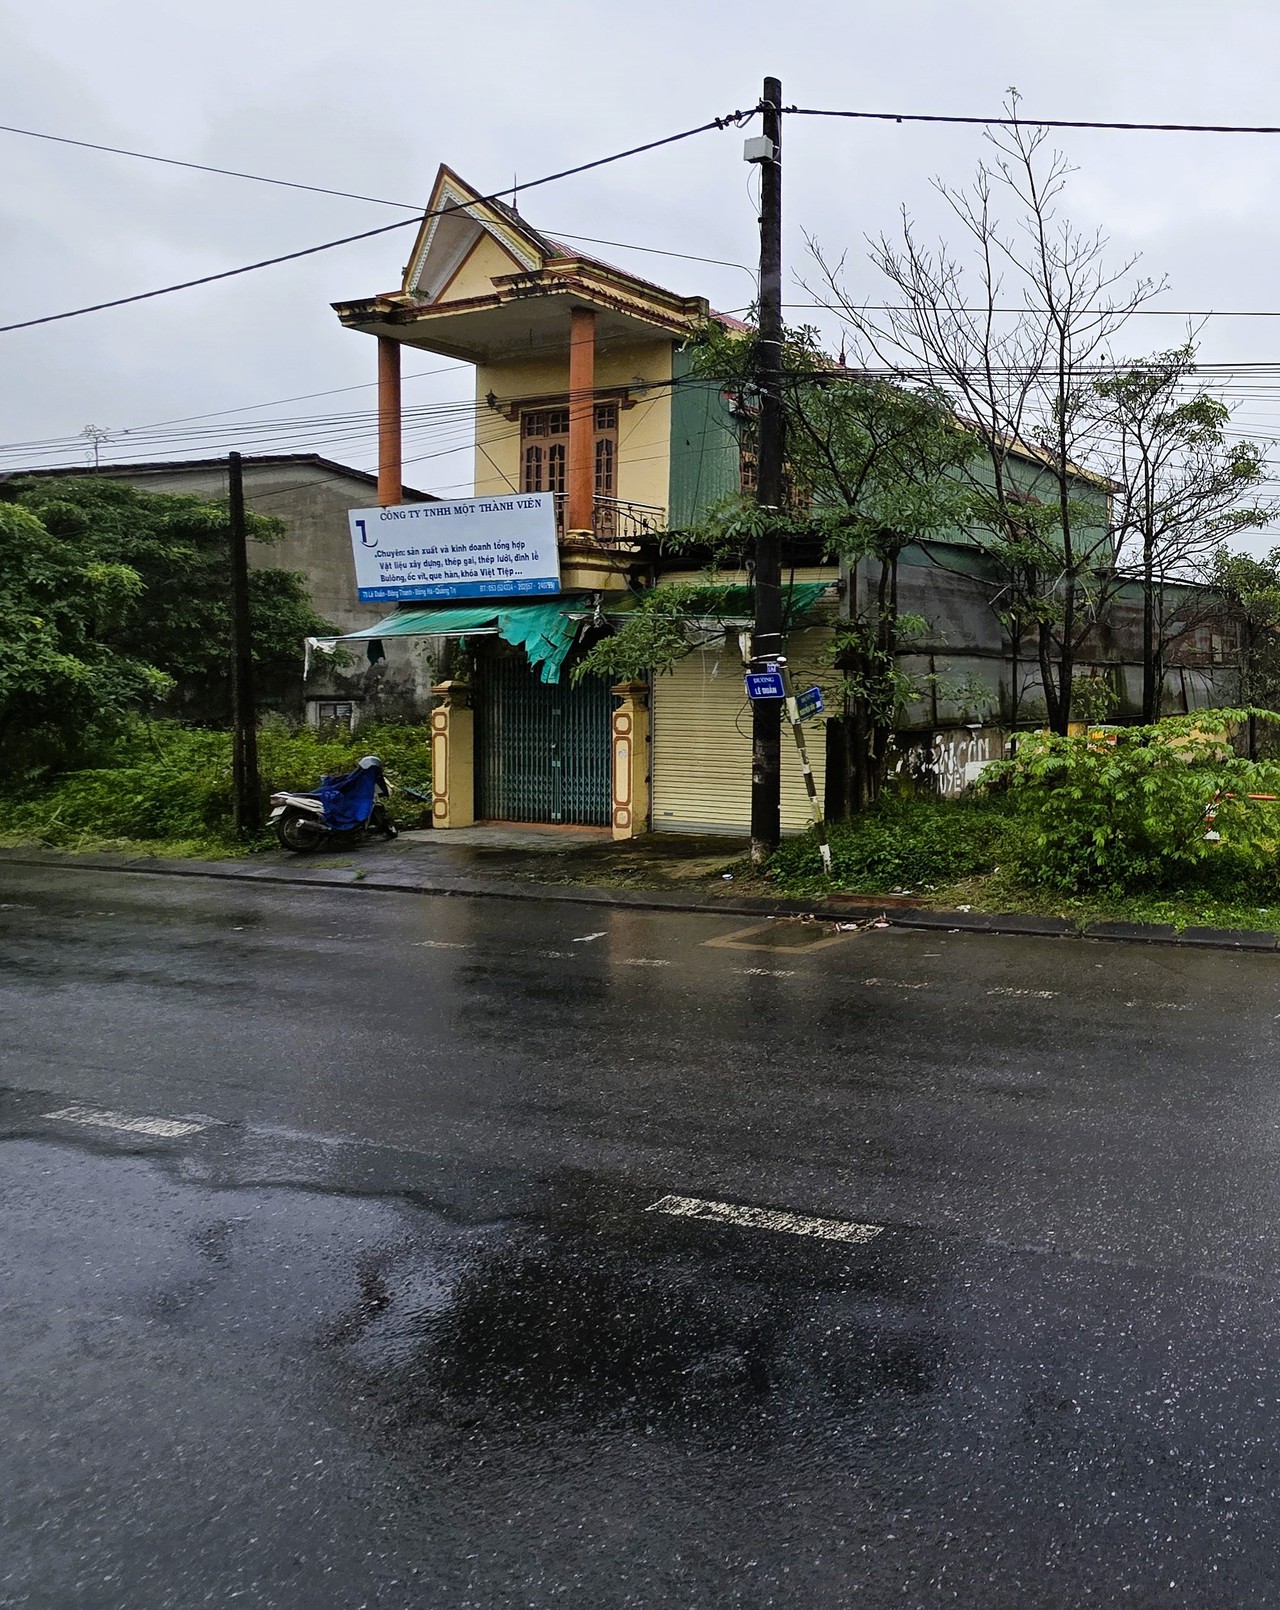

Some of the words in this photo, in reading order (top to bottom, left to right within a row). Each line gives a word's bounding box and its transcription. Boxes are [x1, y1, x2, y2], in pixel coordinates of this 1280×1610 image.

[380, 509, 406, 521] CÔNG
[408, 510, 421, 519] TY
[424, 508, 451, 518] TNHH
[454, 503, 476, 517] MỘT
[480, 499, 514, 513] THÀNH
[517, 497, 542, 510] VIÊN
[440, 544, 450, 554] và
[451, 544, 467, 552] kinh
[468, 542, 491, 551] doanh
[493, 539, 510, 550] tổng
[511, 541, 526, 550] hợp
[379, 562, 393, 572] Vật
[394, 561, 408, 571] liệu
[409, 559, 421, 569] xây
[444, 557, 461, 567] thép
[478, 555, 494, 564] thép
[428, 572, 442, 581] que
[479, 567, 495, 578] Việt
[755, 686, 762, 695] LÊ
